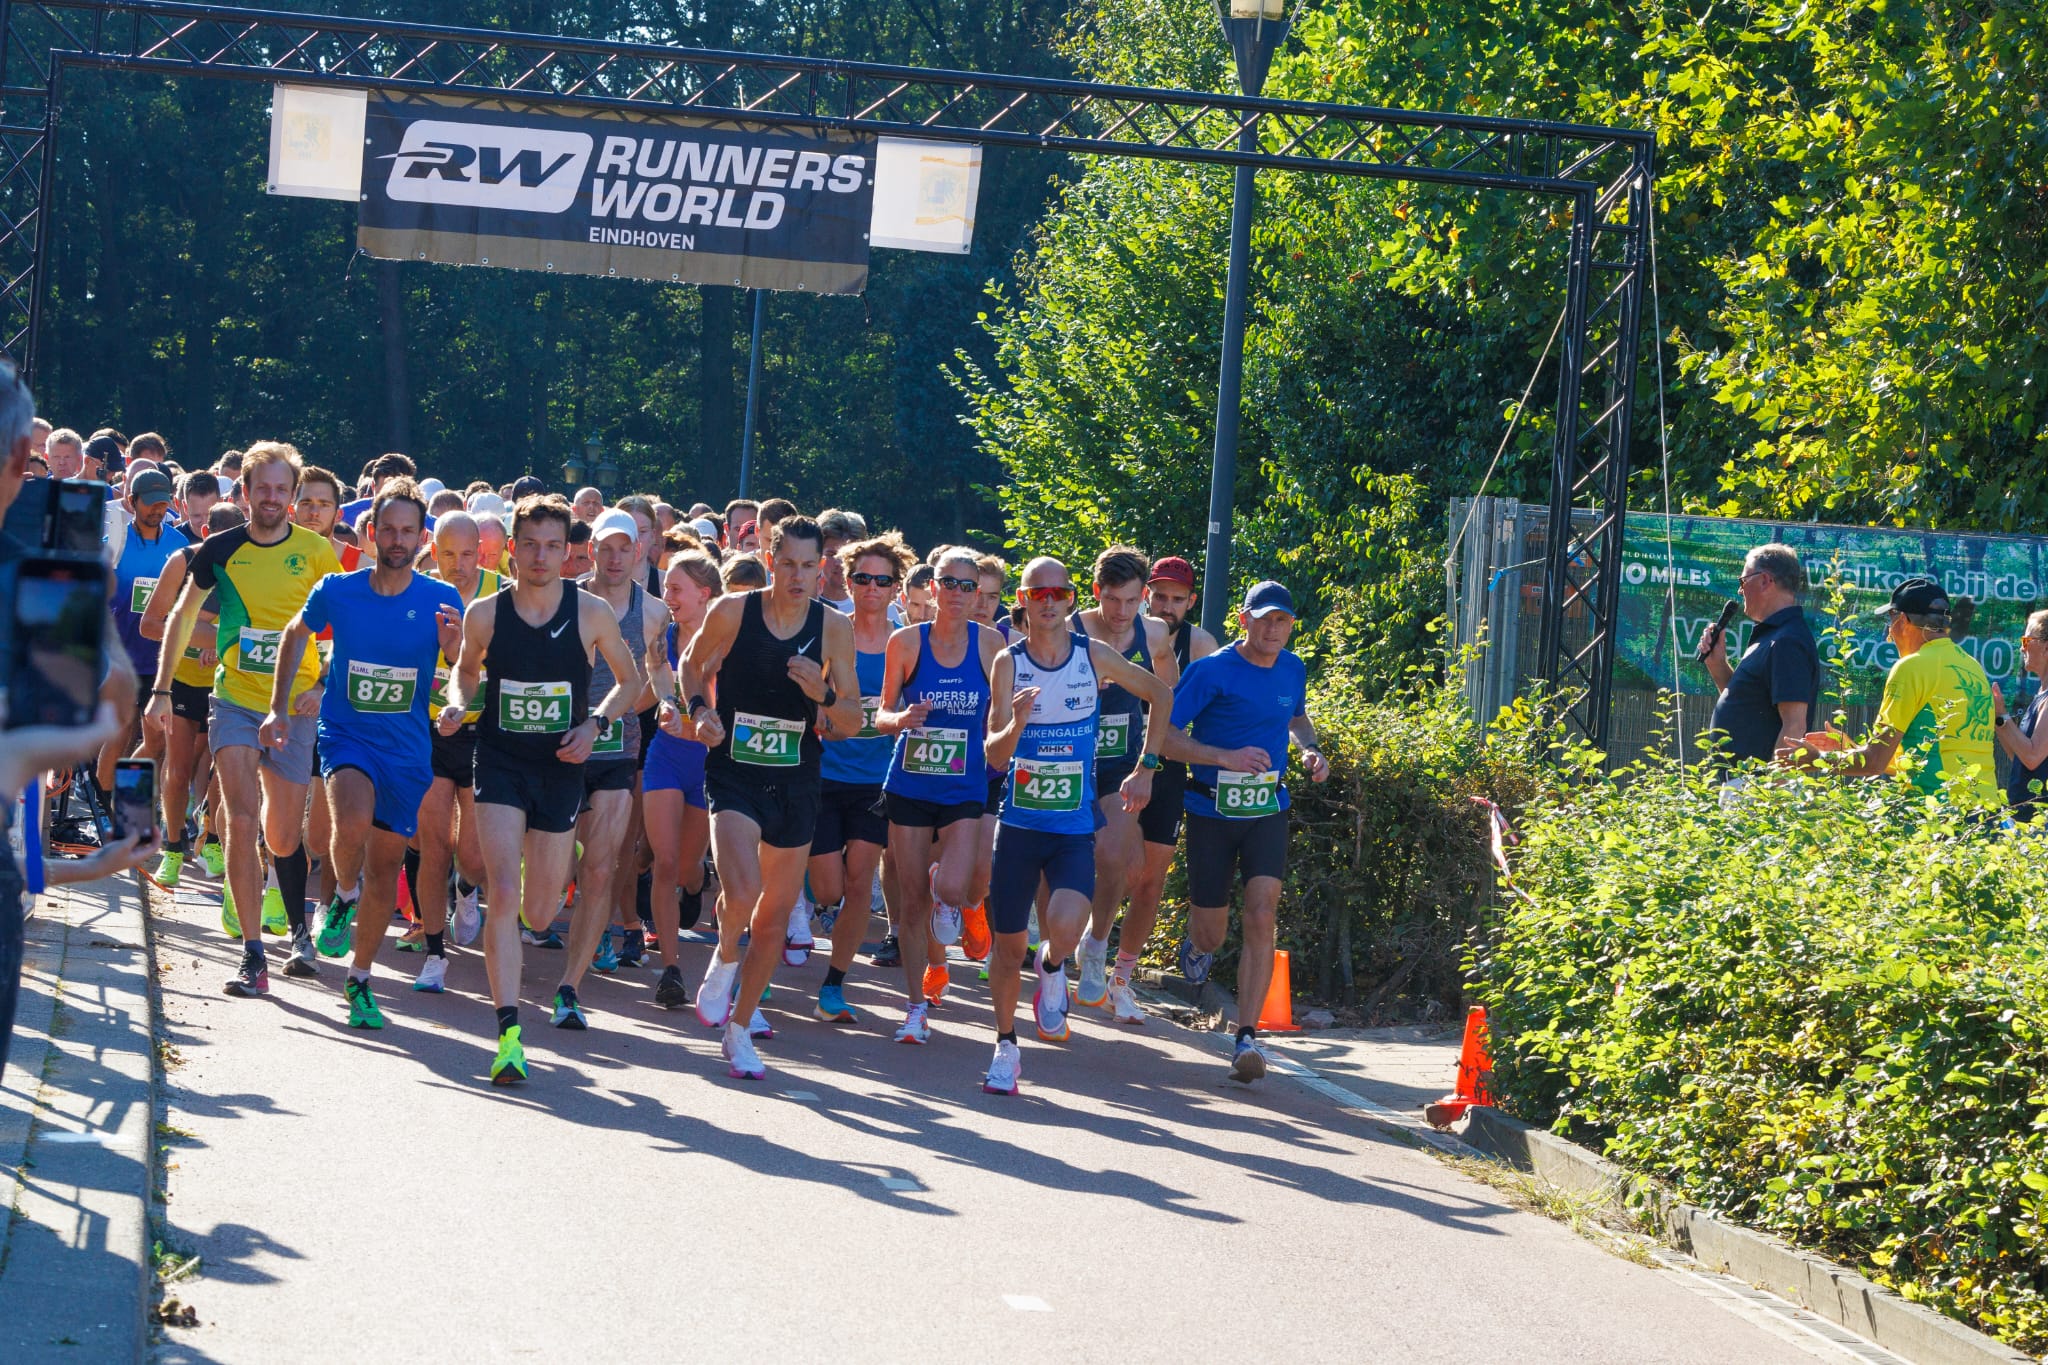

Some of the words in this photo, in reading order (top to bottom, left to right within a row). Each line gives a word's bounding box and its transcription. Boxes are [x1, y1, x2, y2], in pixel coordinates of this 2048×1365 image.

[398, 141, 576, 188] RW
[596, 135, 866, 194] RUNNERS
[590, 178, 786, 230] WORLD
[588, 226, 695, 250] EINDHOVEN
[1650, 565, 1711, 587] MILES
[1805, 560, 1938, 593] Welko
[1946, 570, 1988, 605] bij
[1994, 573, 2037, 602] de
[357, 679, 404, 703] 873
[920, 691, 967, 701] LOPERS
[509, 698, 562, 721] 594
[921, 700, 967, 710] MPANY
[946, 708, 977, 716] TILBURG
[737, 716, 757, 725] ASML
[746, 732, 788, 754] 421
[913, 742, 958, 765] 407
[1037, 745, 1066, 753] MHK
[919, 765, 947, 773] MARJON
[1024, 777, 1072, 799] 423
[1226, 787, 1270, 808] 830
